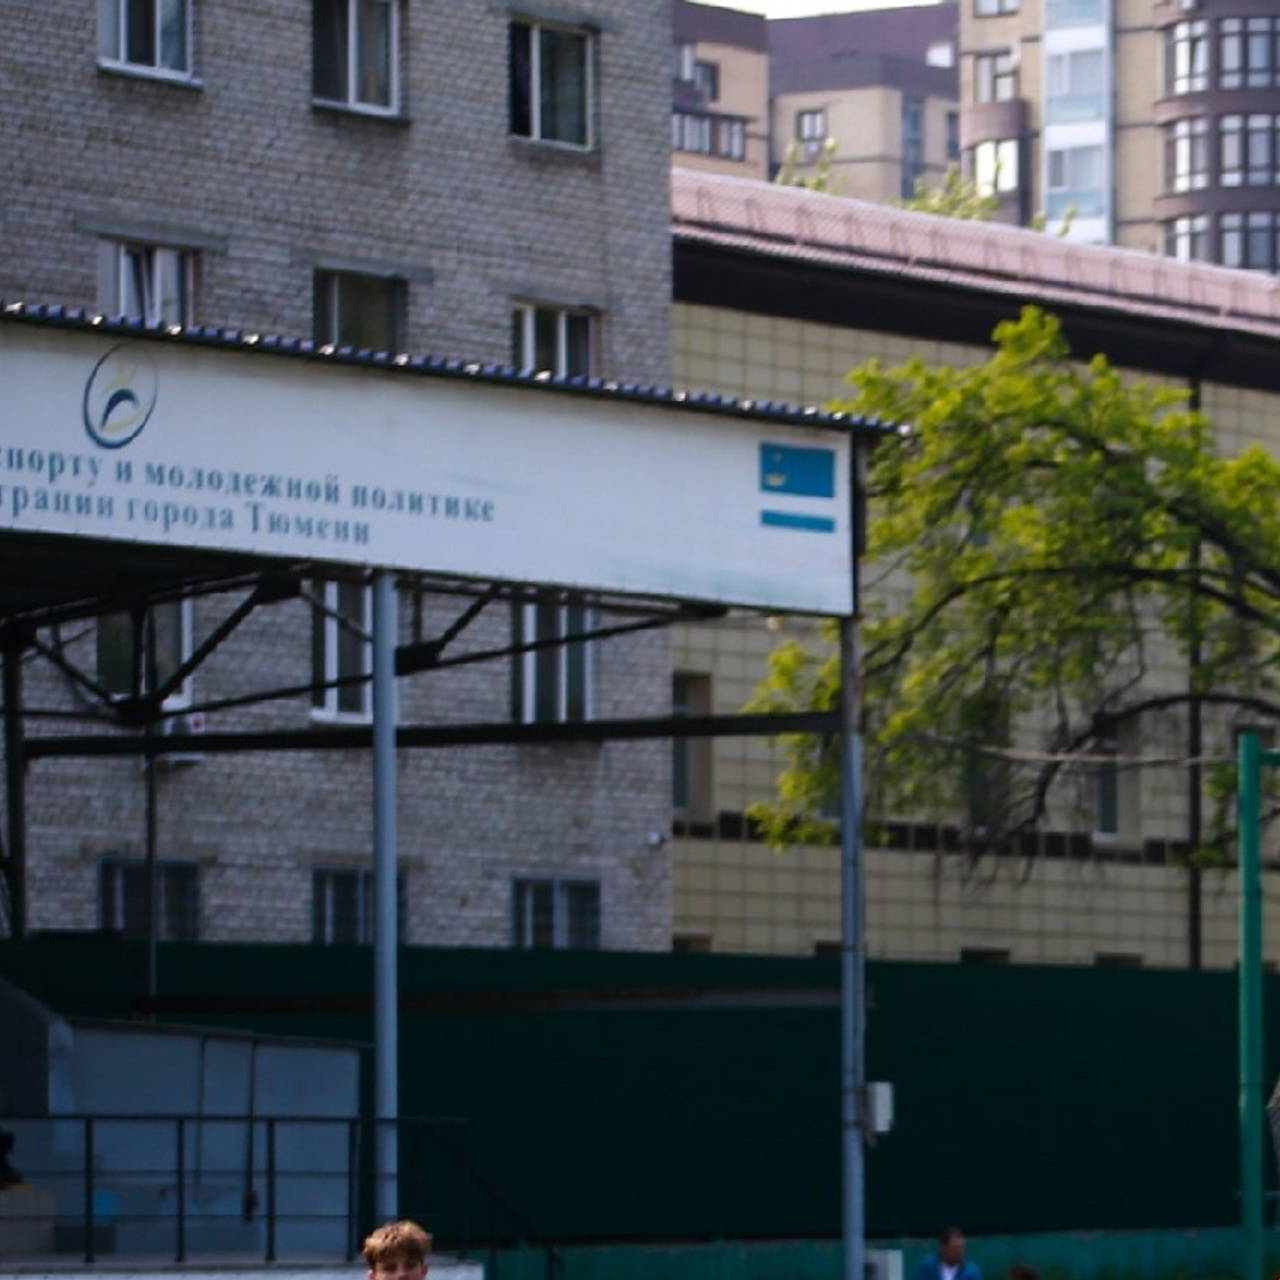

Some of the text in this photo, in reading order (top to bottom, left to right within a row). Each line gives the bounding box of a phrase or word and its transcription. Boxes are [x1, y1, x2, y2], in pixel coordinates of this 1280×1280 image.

[0, 447, 496, 523] порту и молодежной политике
[128, 497, 235, 534] города
[246, 501, 370, 546] Тюмени
